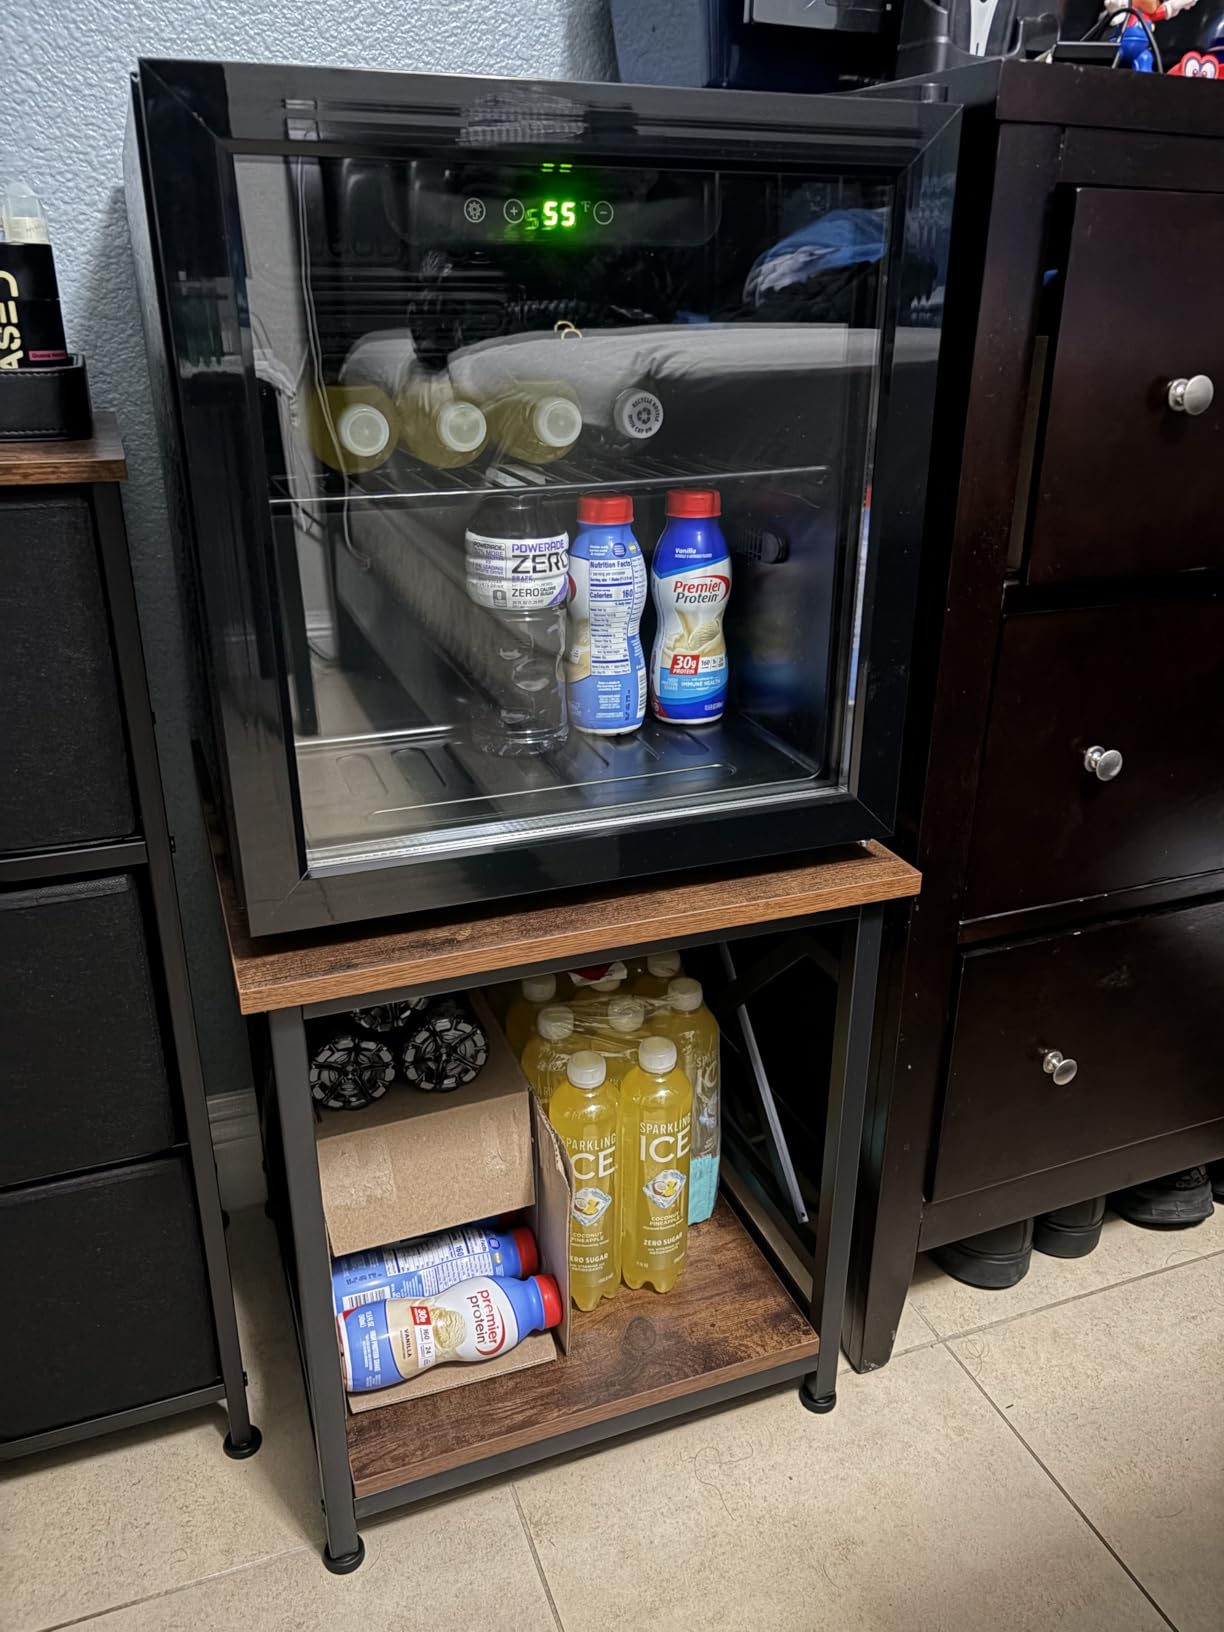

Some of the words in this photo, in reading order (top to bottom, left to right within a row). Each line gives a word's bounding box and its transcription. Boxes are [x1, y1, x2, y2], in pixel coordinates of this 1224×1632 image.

[543, 200, 576, 227] 55
[512, 539, 564, 553] POWERADE
[617, 560, 631, 568] Facts
[512, 588, 540, 598] ZERO
[673, 579, 722, 594] Premier
[590, 591, 613, 599] Calories
[622, 589, 633, 599] 160
[675, 591, 718, 604] Protein
[673, 656, 697, 669] 30g
[639, 1112, 691, 1135] SPARKLING
[640, 1125, 691, 1163] ICE
[570, 1146, 618, 1180] CE
[649, 1216, 680, 1226] PINEAPPLE
[651, 1211, 679, 1221] COCONUT
[572, 1231, 602, 1239] COCONUT
[643, 1238, 663, 1246] ZERO
[663, 1231, 683, 1246] SUGAR
[570, 1255, 584, 1264] ERO
[585, 1252, 609, 1264] SUGAR
[466, 1295, 487, 1343] protein
[477, 1289, 499, 1345] premier
[404, 1328, 413, 1358] VANILLA
